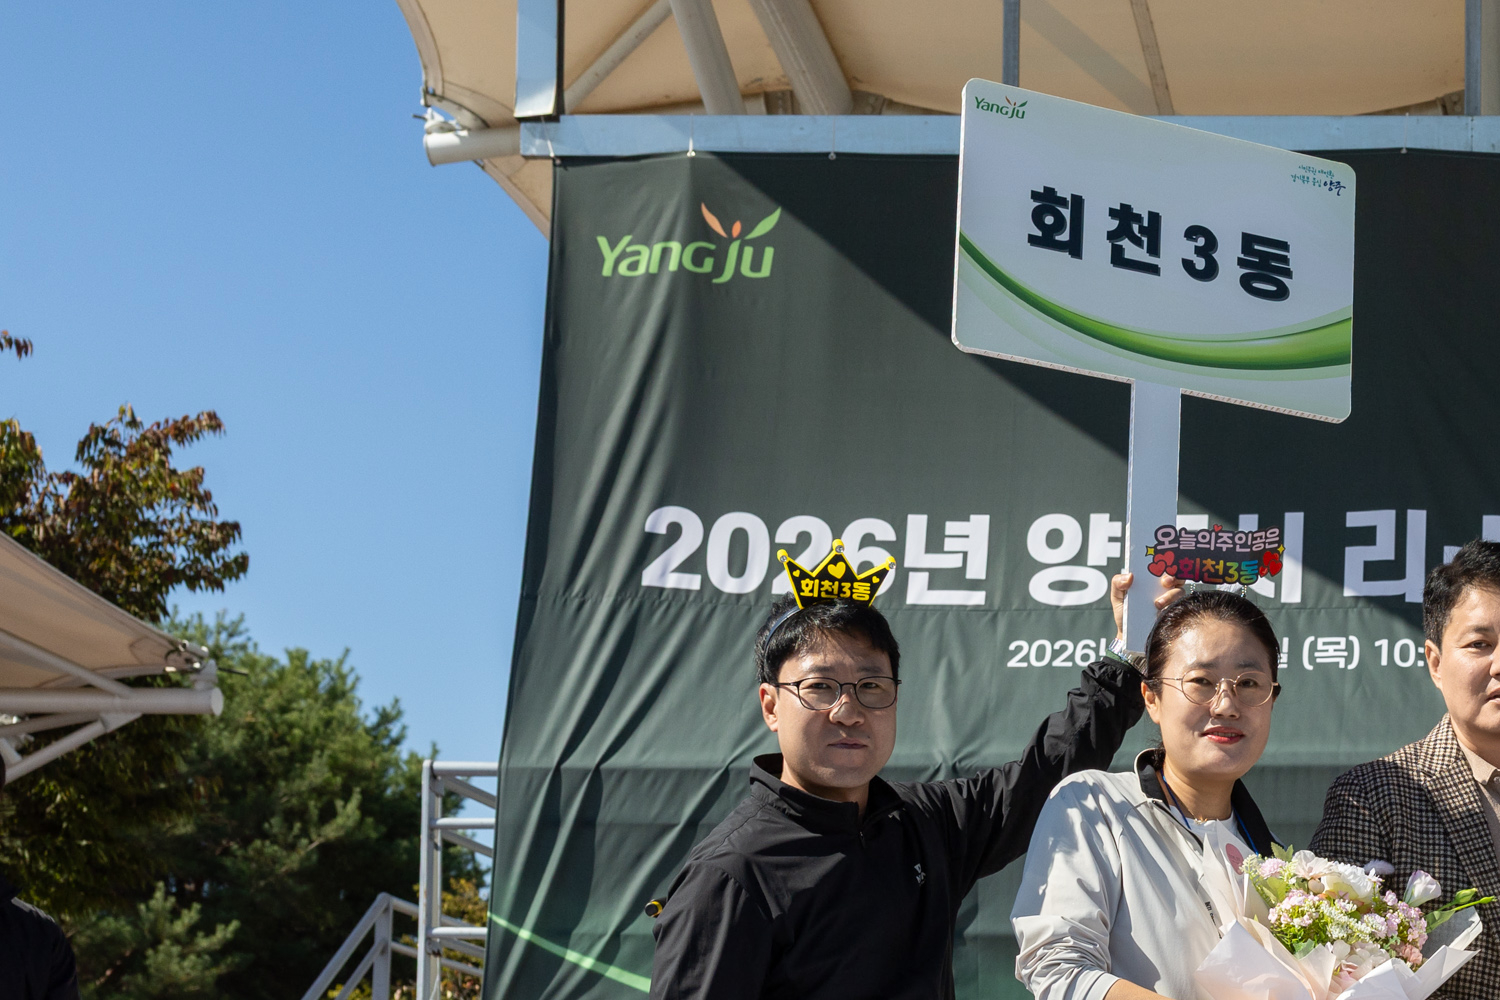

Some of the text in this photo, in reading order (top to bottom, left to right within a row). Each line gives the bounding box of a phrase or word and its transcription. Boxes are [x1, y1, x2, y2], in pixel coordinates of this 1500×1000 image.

[1323, 180, 1347, 197] 양주
[1026, 511, 1305, 606] 양시
[1178, 557, 1259, 585] 회천3동
[800, 577, 872, 602] 회천3동
[1302, 635, 1361, 671] (목)
